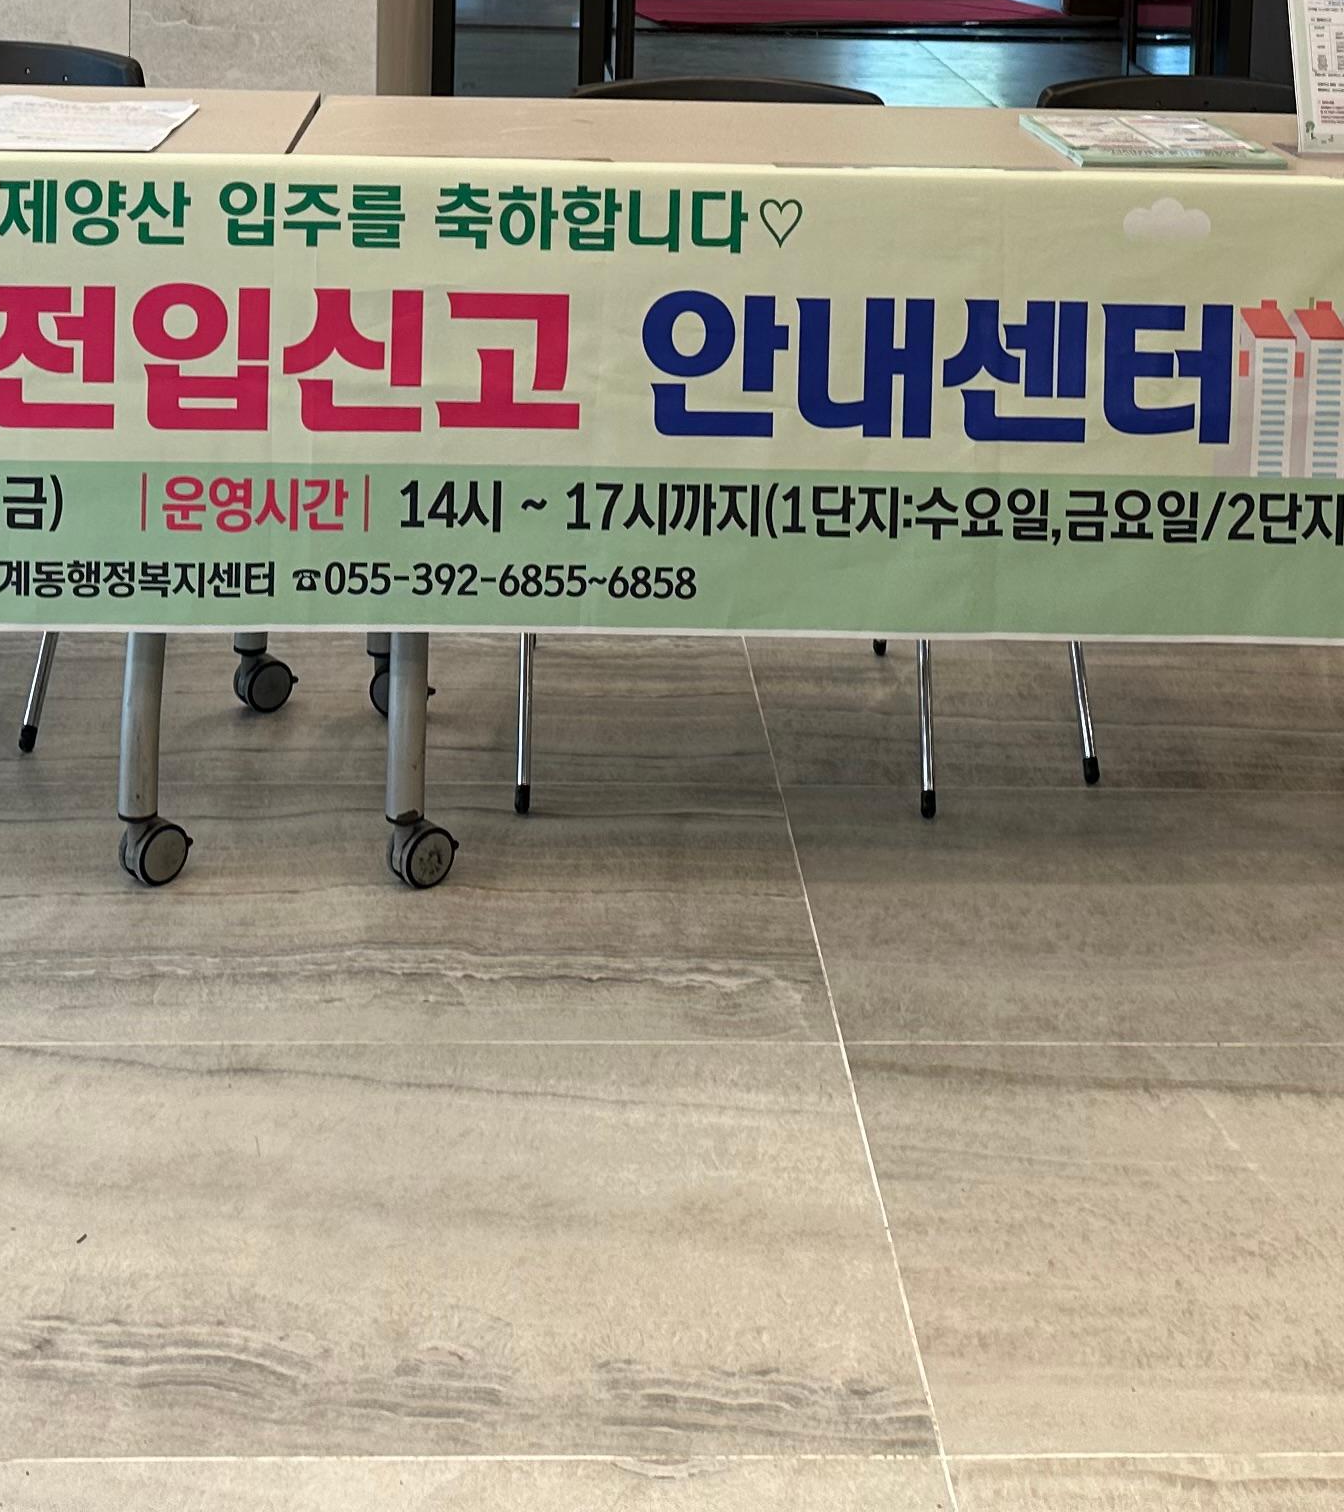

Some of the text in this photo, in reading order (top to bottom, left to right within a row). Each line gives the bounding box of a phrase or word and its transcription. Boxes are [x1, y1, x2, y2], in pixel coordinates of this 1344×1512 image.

[219, 182, 406, 249] 입주를
[435, 183, 750, 253] 축하합니다
[641, 290, 1234, 445] 안내센터
[162, 475, 349, 533] 운영시간
[400, 480, 503, 533] 14시
